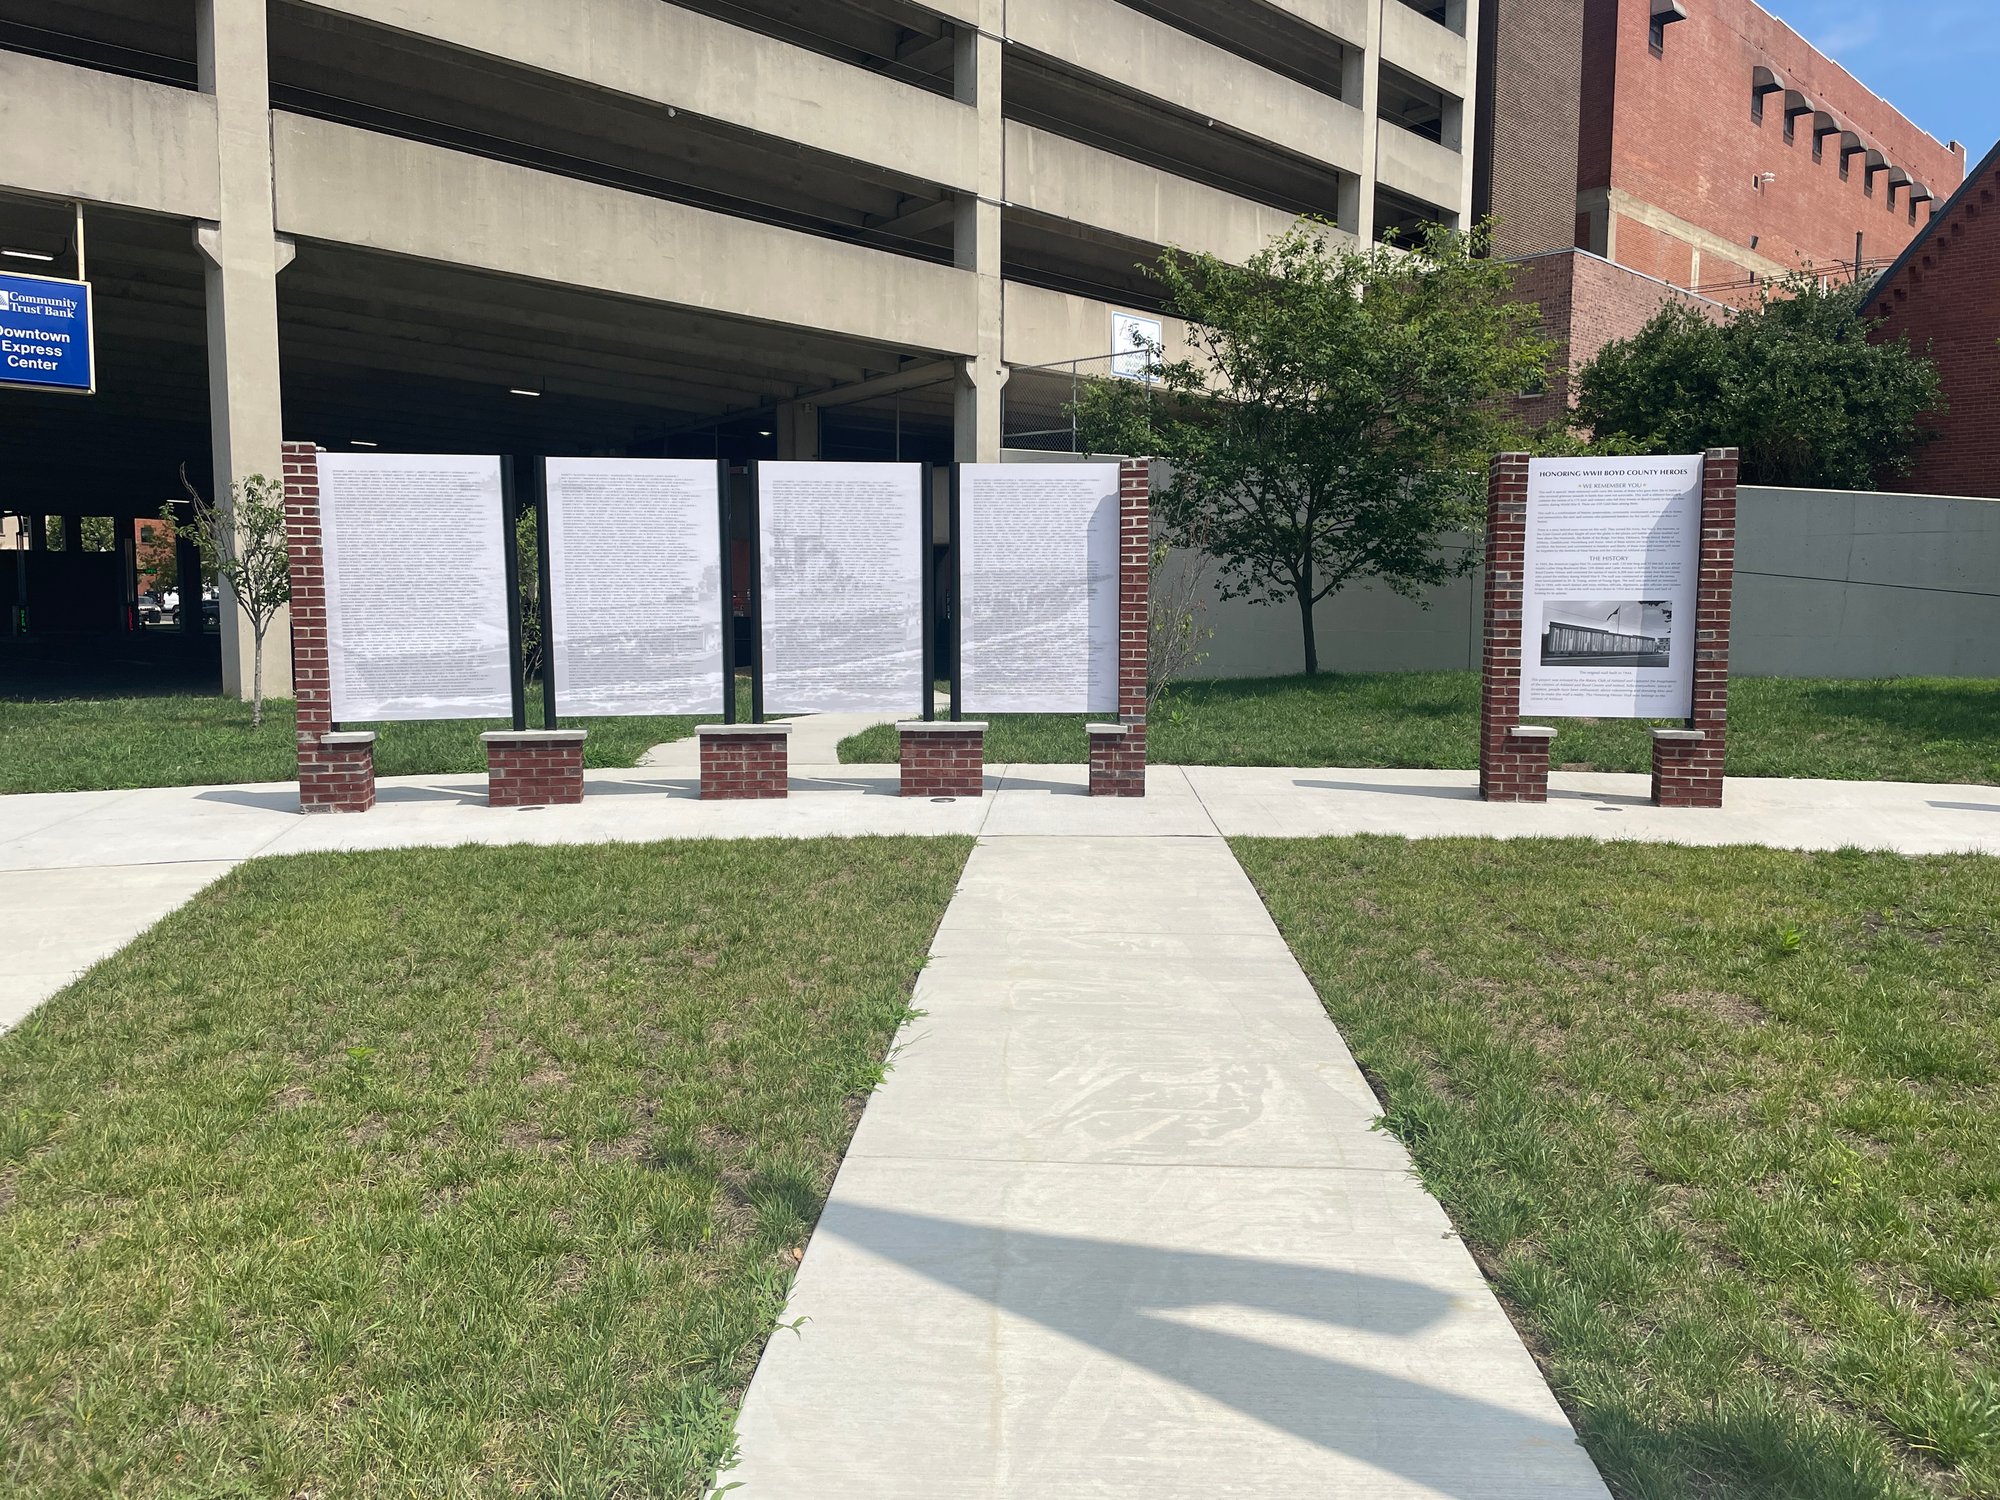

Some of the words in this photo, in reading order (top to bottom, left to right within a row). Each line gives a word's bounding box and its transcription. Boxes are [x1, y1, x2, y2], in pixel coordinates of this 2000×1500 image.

[9, 291, 78, 310] Community
[10, 302, 41, 315] Trust
[45, 306, 75, 319] Bank
[2, 340, 63, 357] Express
[7, 355, 58, 371] Center
